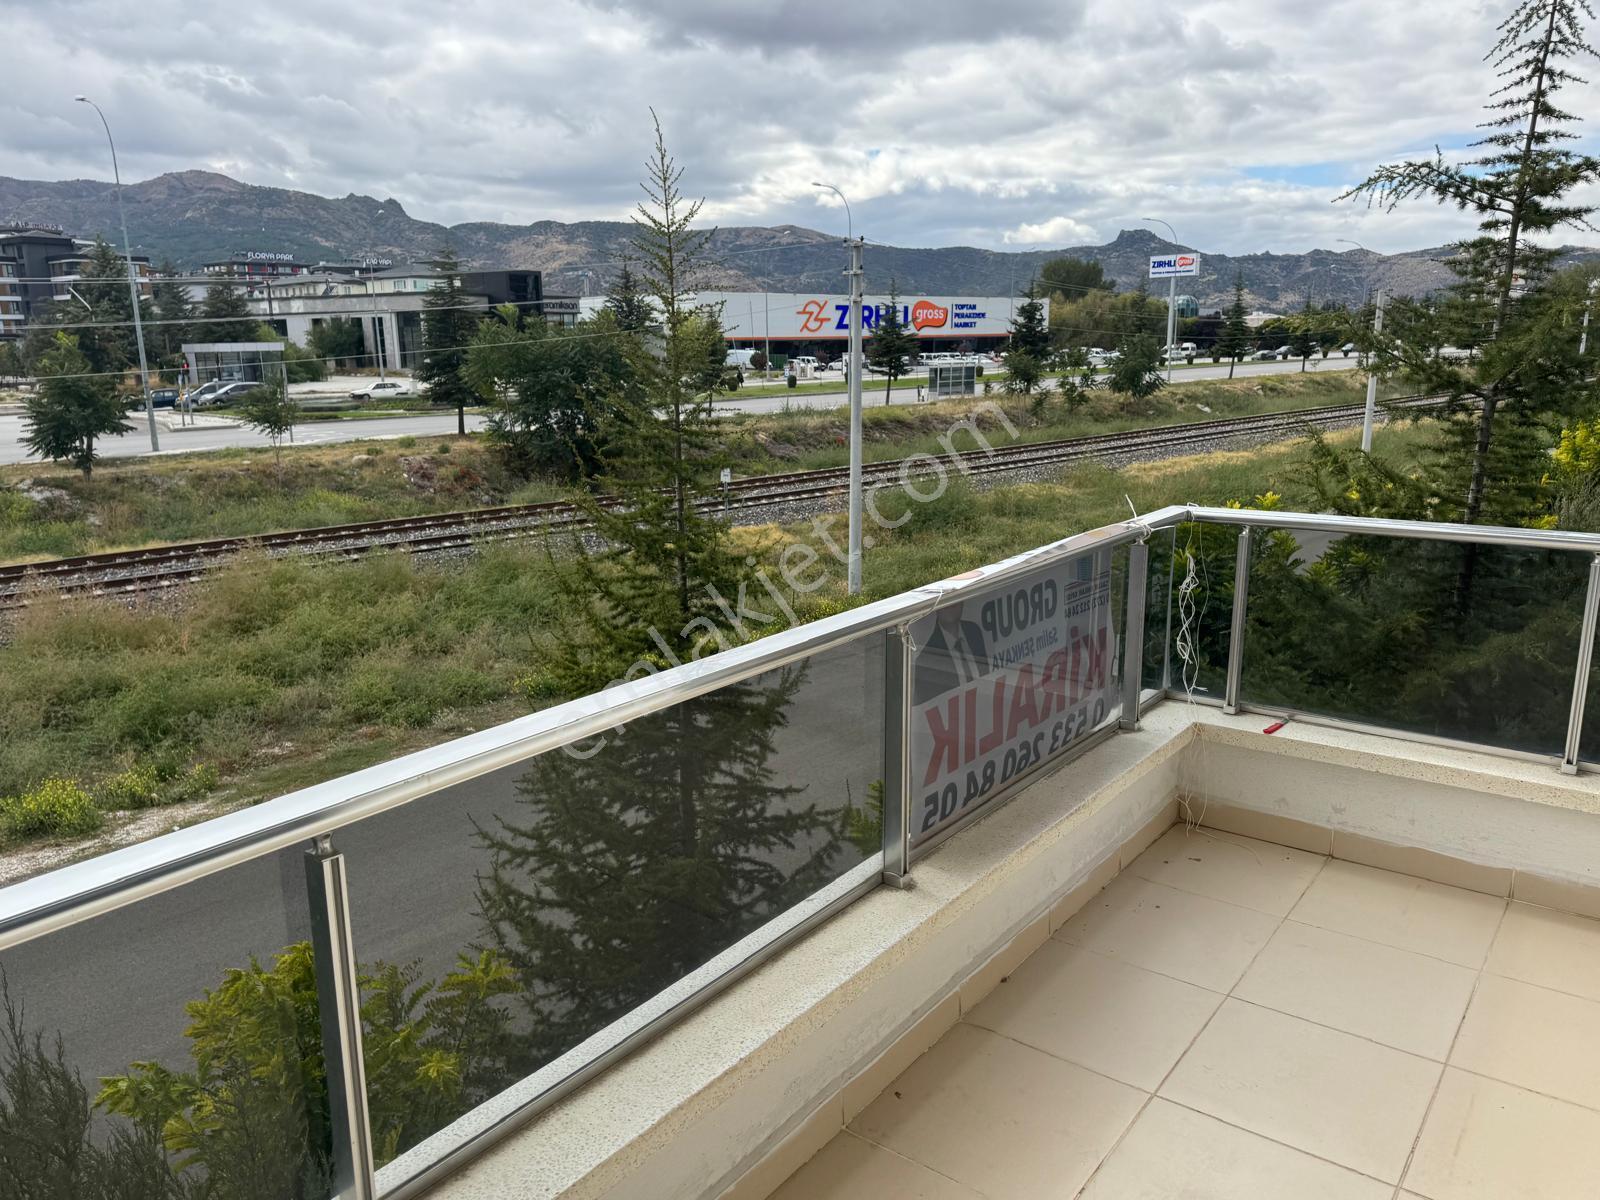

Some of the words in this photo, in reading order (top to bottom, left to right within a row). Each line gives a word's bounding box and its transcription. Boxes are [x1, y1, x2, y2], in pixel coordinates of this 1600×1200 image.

[247, 251, 275, 260] FLORYA
[275, 252, 294, 261] PARK
[954, 303, 977, 311] TOPTAN
[916, 309, 944, 322] gross
